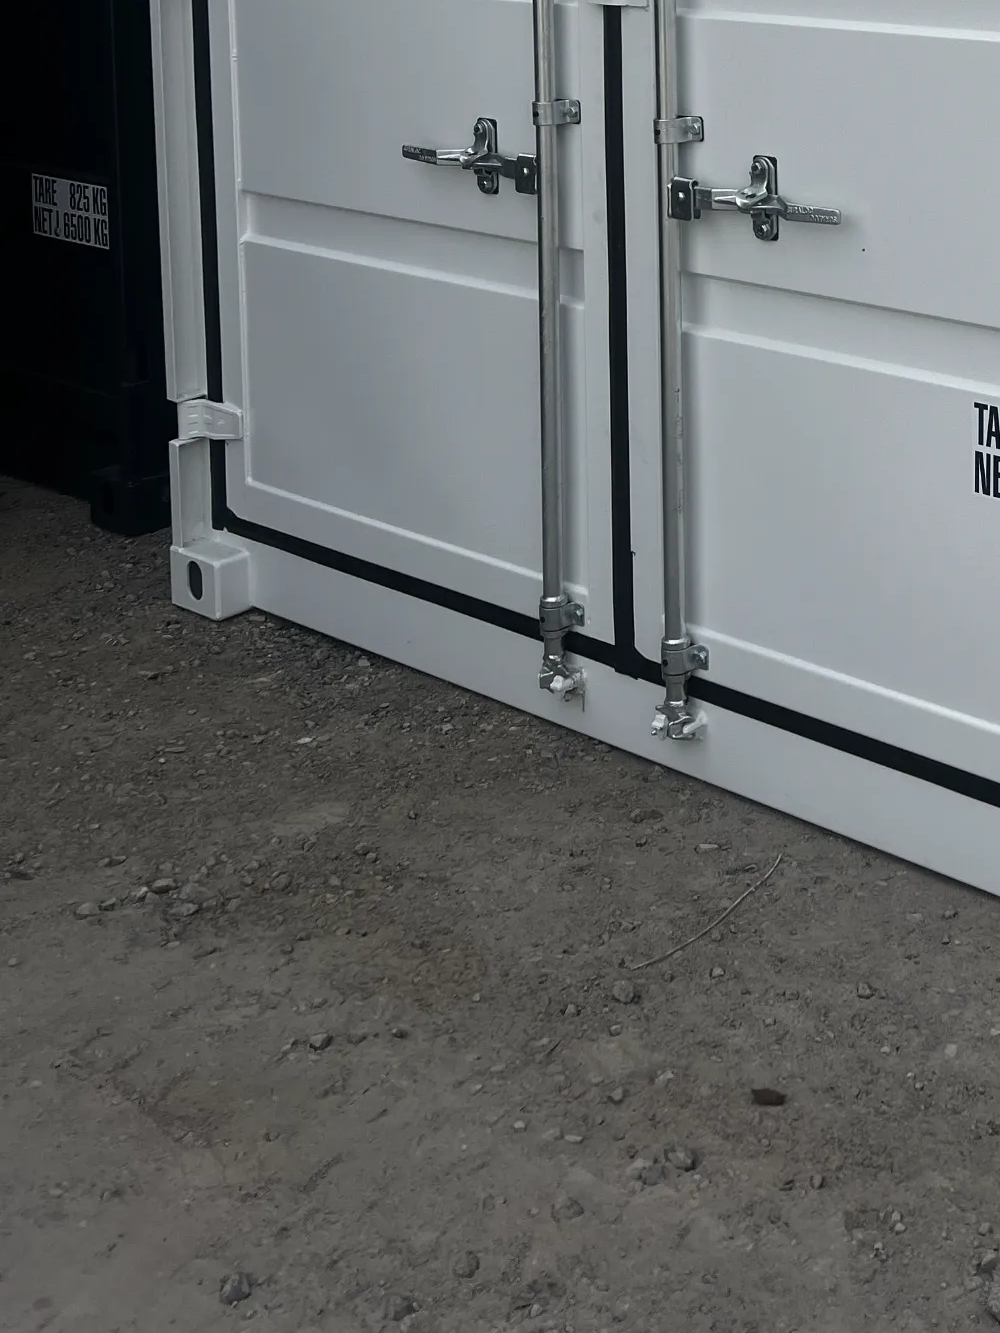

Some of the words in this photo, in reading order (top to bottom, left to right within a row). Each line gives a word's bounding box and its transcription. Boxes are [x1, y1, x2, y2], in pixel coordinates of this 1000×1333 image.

[32, 175, 58, 207] TARE
[69, 182, 90, 213] 825
[92, 186, 108, 217] KG
[34, 206, 54, 236] NET
[63, 211, 92, 244] 6500
[93, 217, 109, 248] KG
